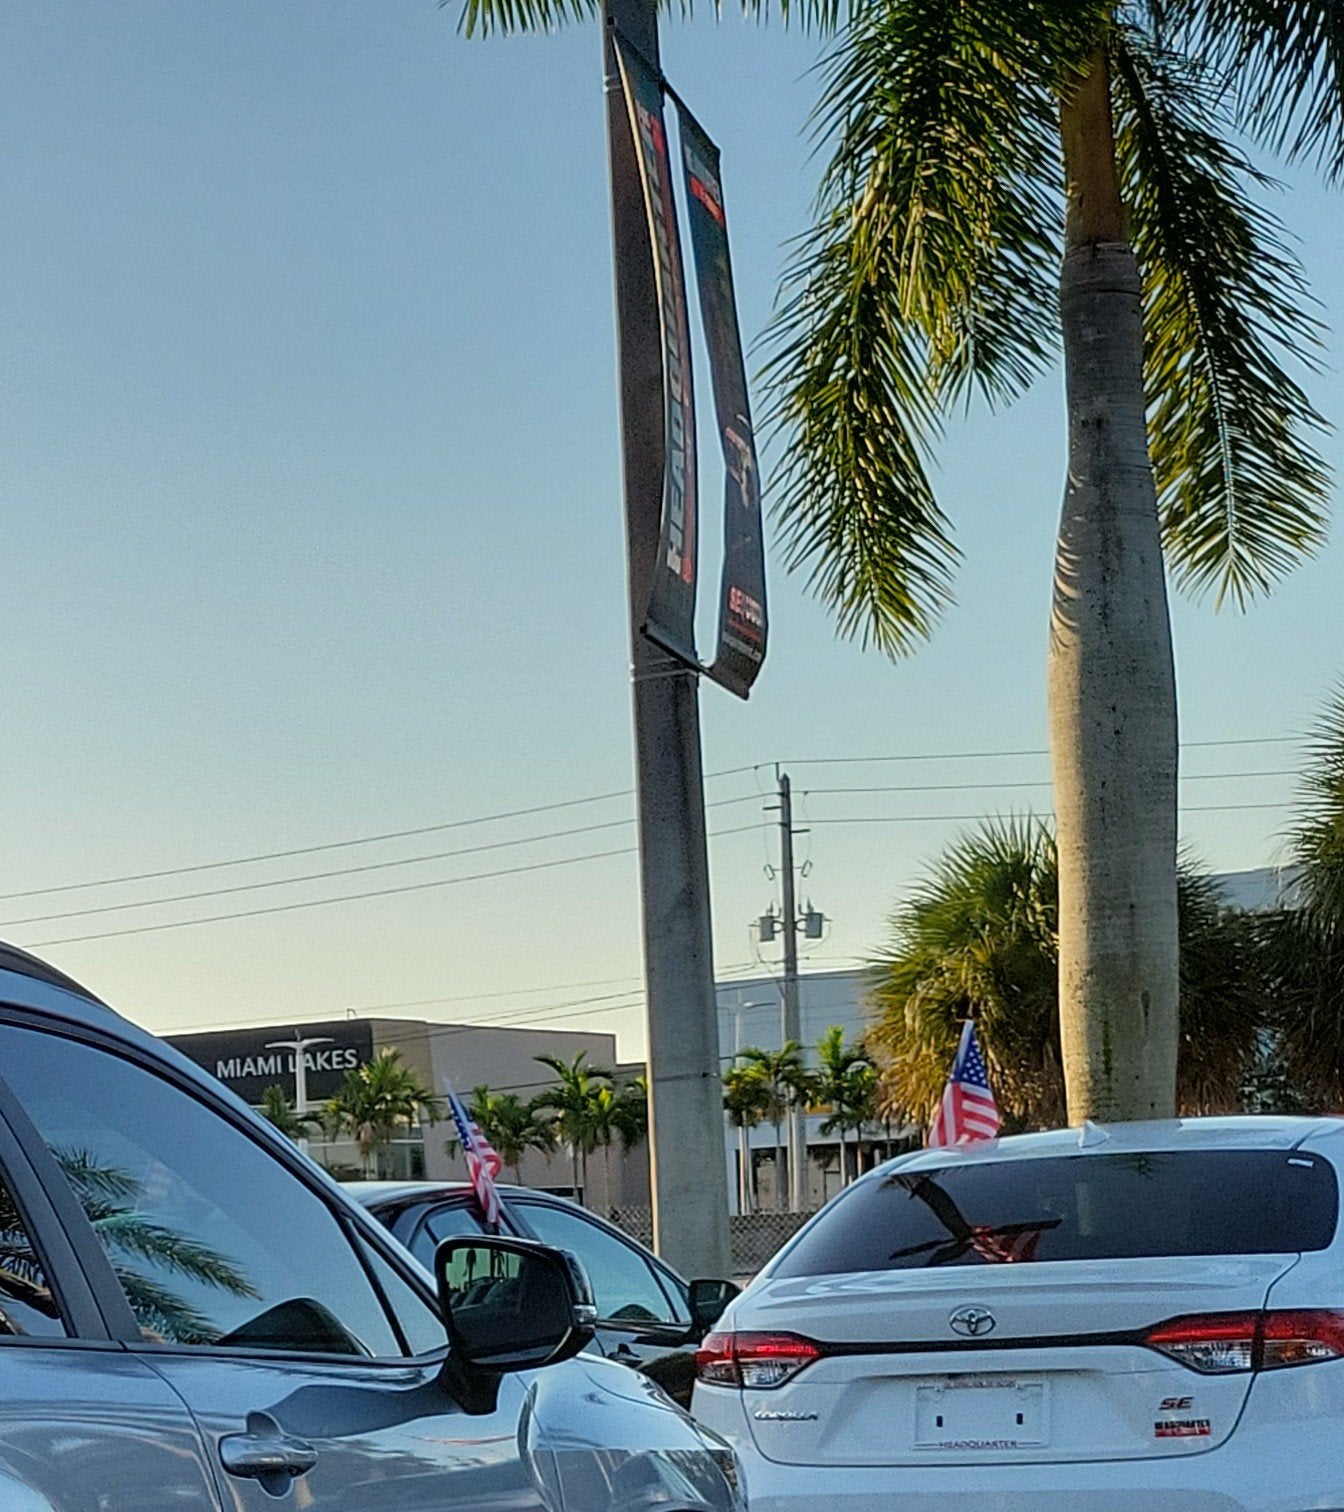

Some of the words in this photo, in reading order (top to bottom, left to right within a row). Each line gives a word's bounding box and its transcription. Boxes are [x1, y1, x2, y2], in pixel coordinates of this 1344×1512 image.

[216, 1055, 282, 1078] MIAMI
[288, 1049, 358, 1073] LAKES
[1159, 1396, 1194, 1411] SE
